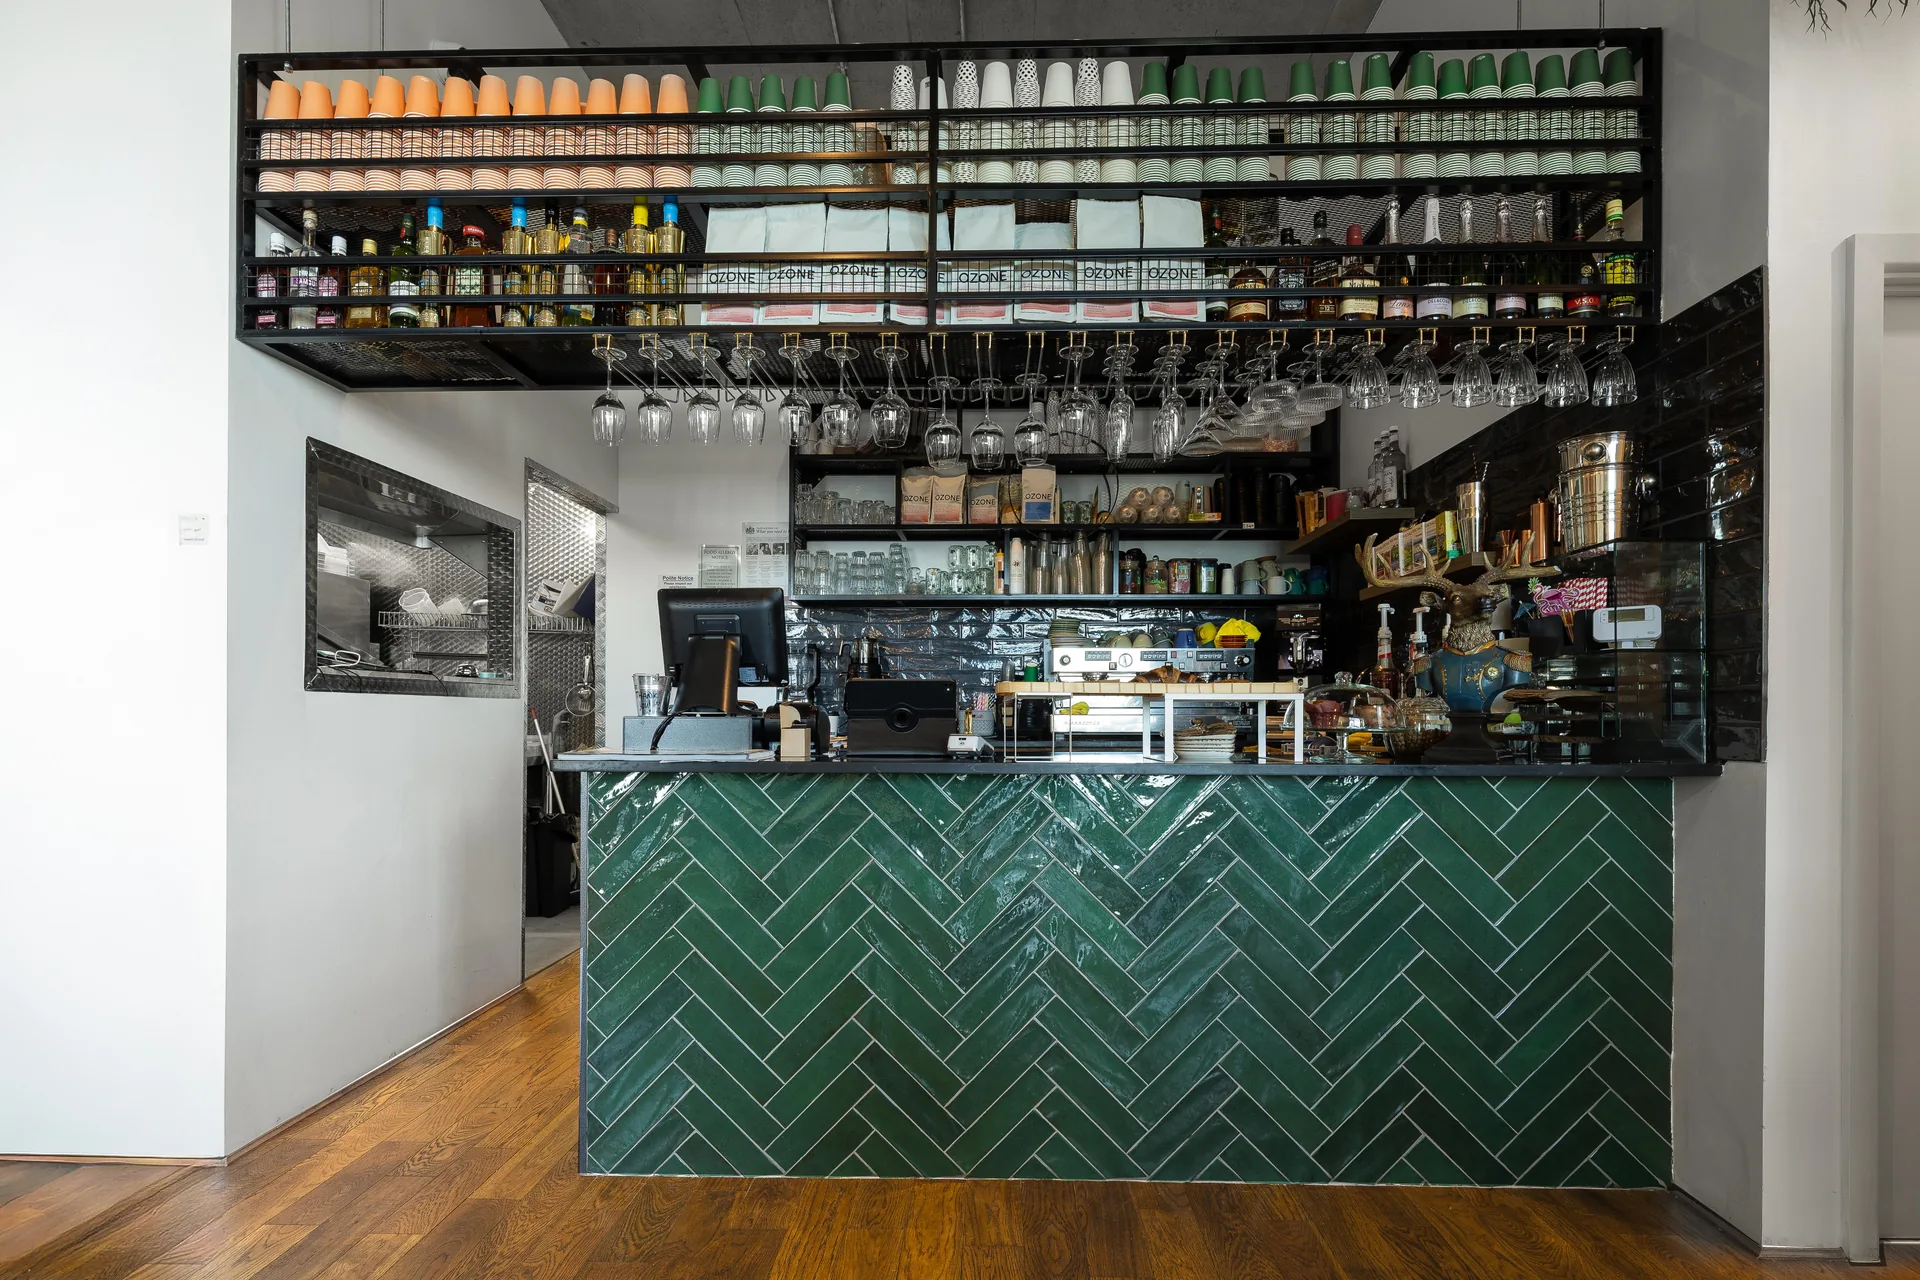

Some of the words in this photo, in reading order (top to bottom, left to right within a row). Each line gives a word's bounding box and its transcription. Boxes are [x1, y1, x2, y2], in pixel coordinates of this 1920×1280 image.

[709, 271, 755, 284] OZONE
[768, 268, 815, 281] OZONE
[830, 265, 879, 278] OZONE
[897, 268, 945, 283] OZOE
[958, 270, 1007, 283] OZONE
[1021, 269, 1071, 281] OZONE
[1084, 266, 1133, 279] OZONE
[1148, 267, 1199, 279] OZONE
[903, 495, 929, 503] OZONE
[935, 494, 961, 502] OZONE
